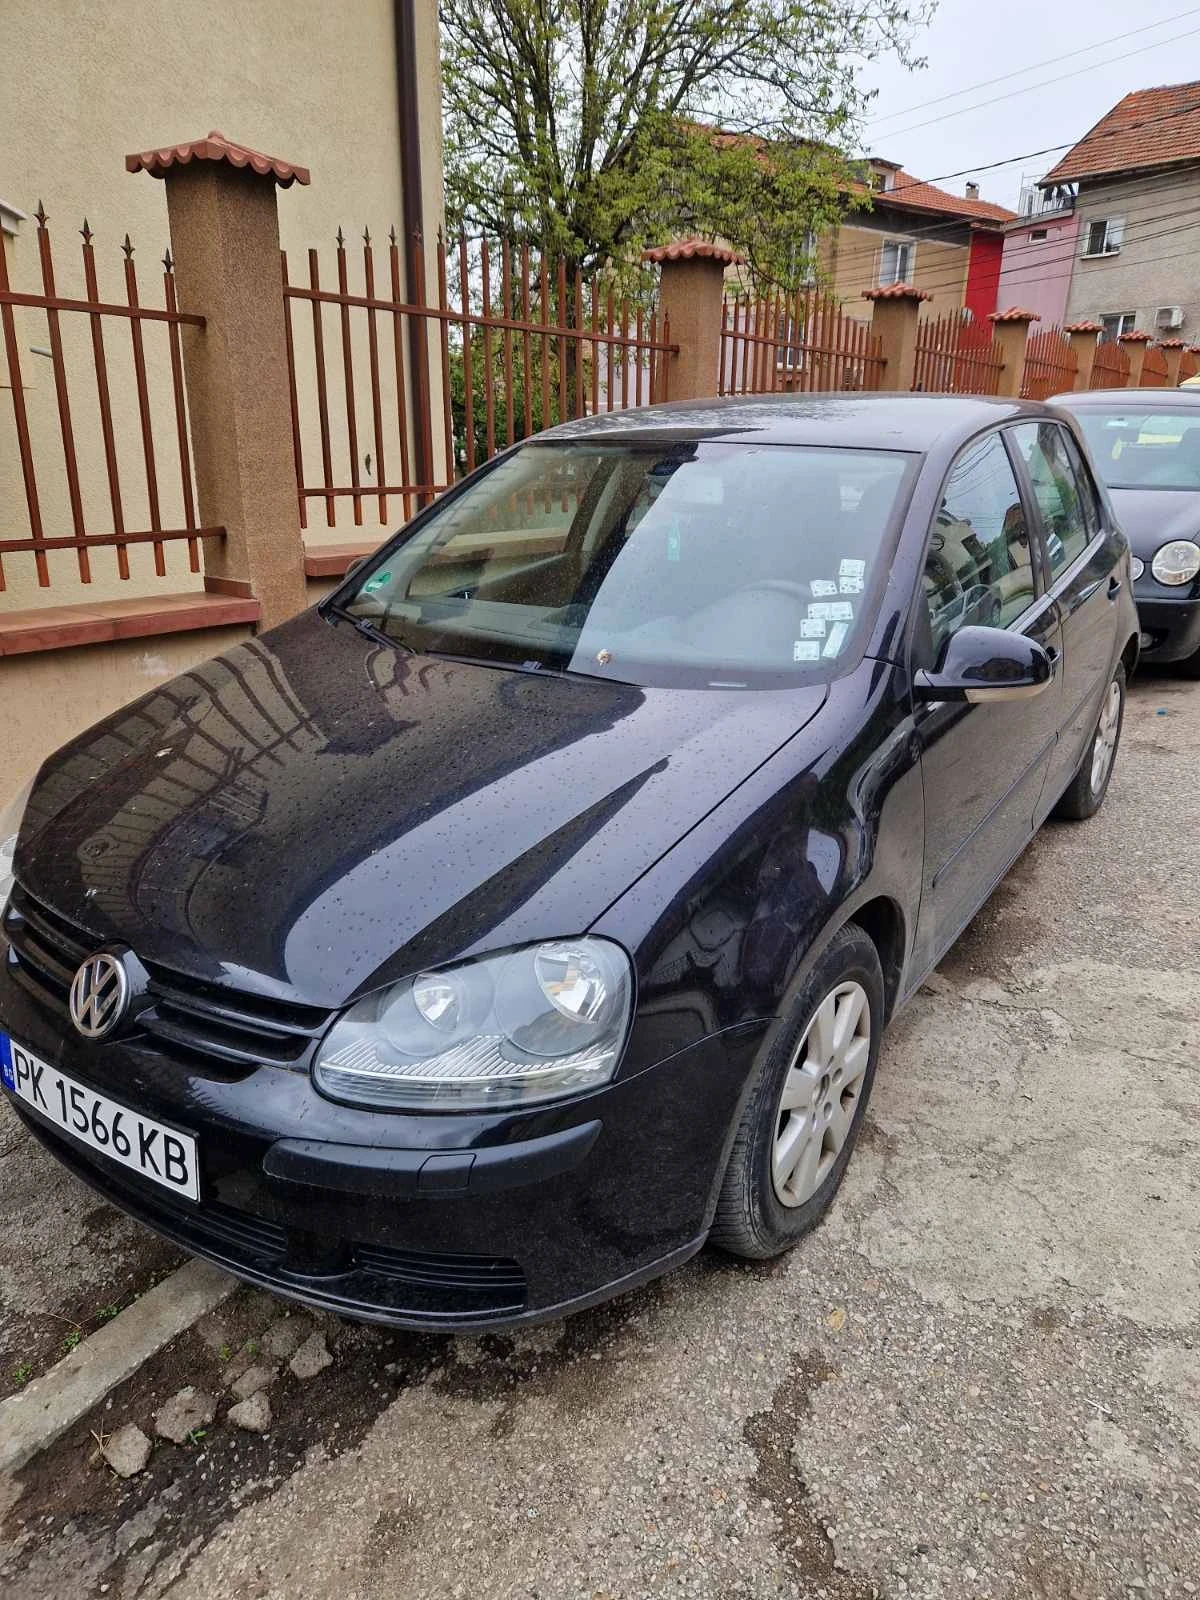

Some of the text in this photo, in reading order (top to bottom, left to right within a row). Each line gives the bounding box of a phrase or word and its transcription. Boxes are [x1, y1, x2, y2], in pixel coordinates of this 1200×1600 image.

[14, 1047, 189, 1186] PK 1566 KB
